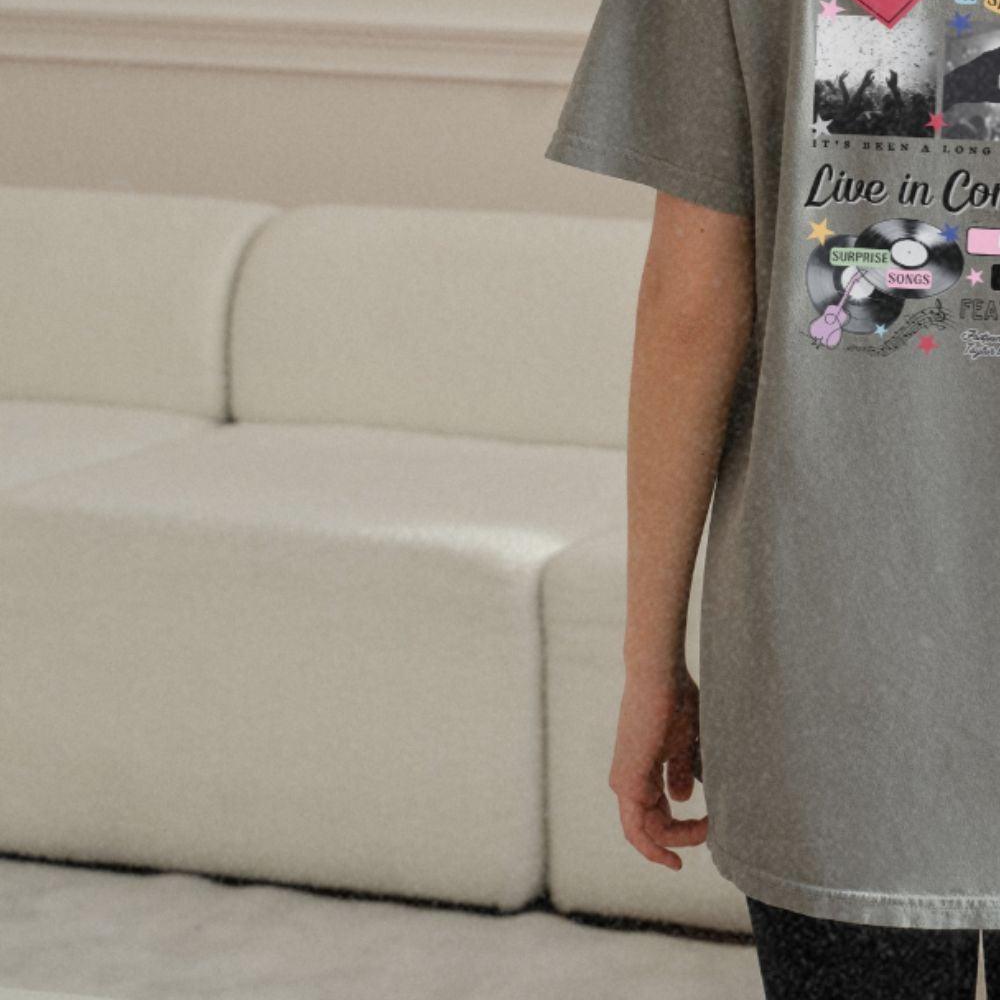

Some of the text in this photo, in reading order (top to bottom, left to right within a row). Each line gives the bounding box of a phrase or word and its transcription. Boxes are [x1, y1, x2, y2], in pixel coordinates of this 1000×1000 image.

[812, 139, 850, 149] IT'S
[862, 142, 909, 151] BEEN
[921, 144, 930, 153] A
[943, 145, 991, 156] LONG
[804, 163, 888, 208] Live
[898, 173, 934, 206] in
[832, 250, 889, 263] SURPRISE
[888, 272, 931, 285] SONGS
